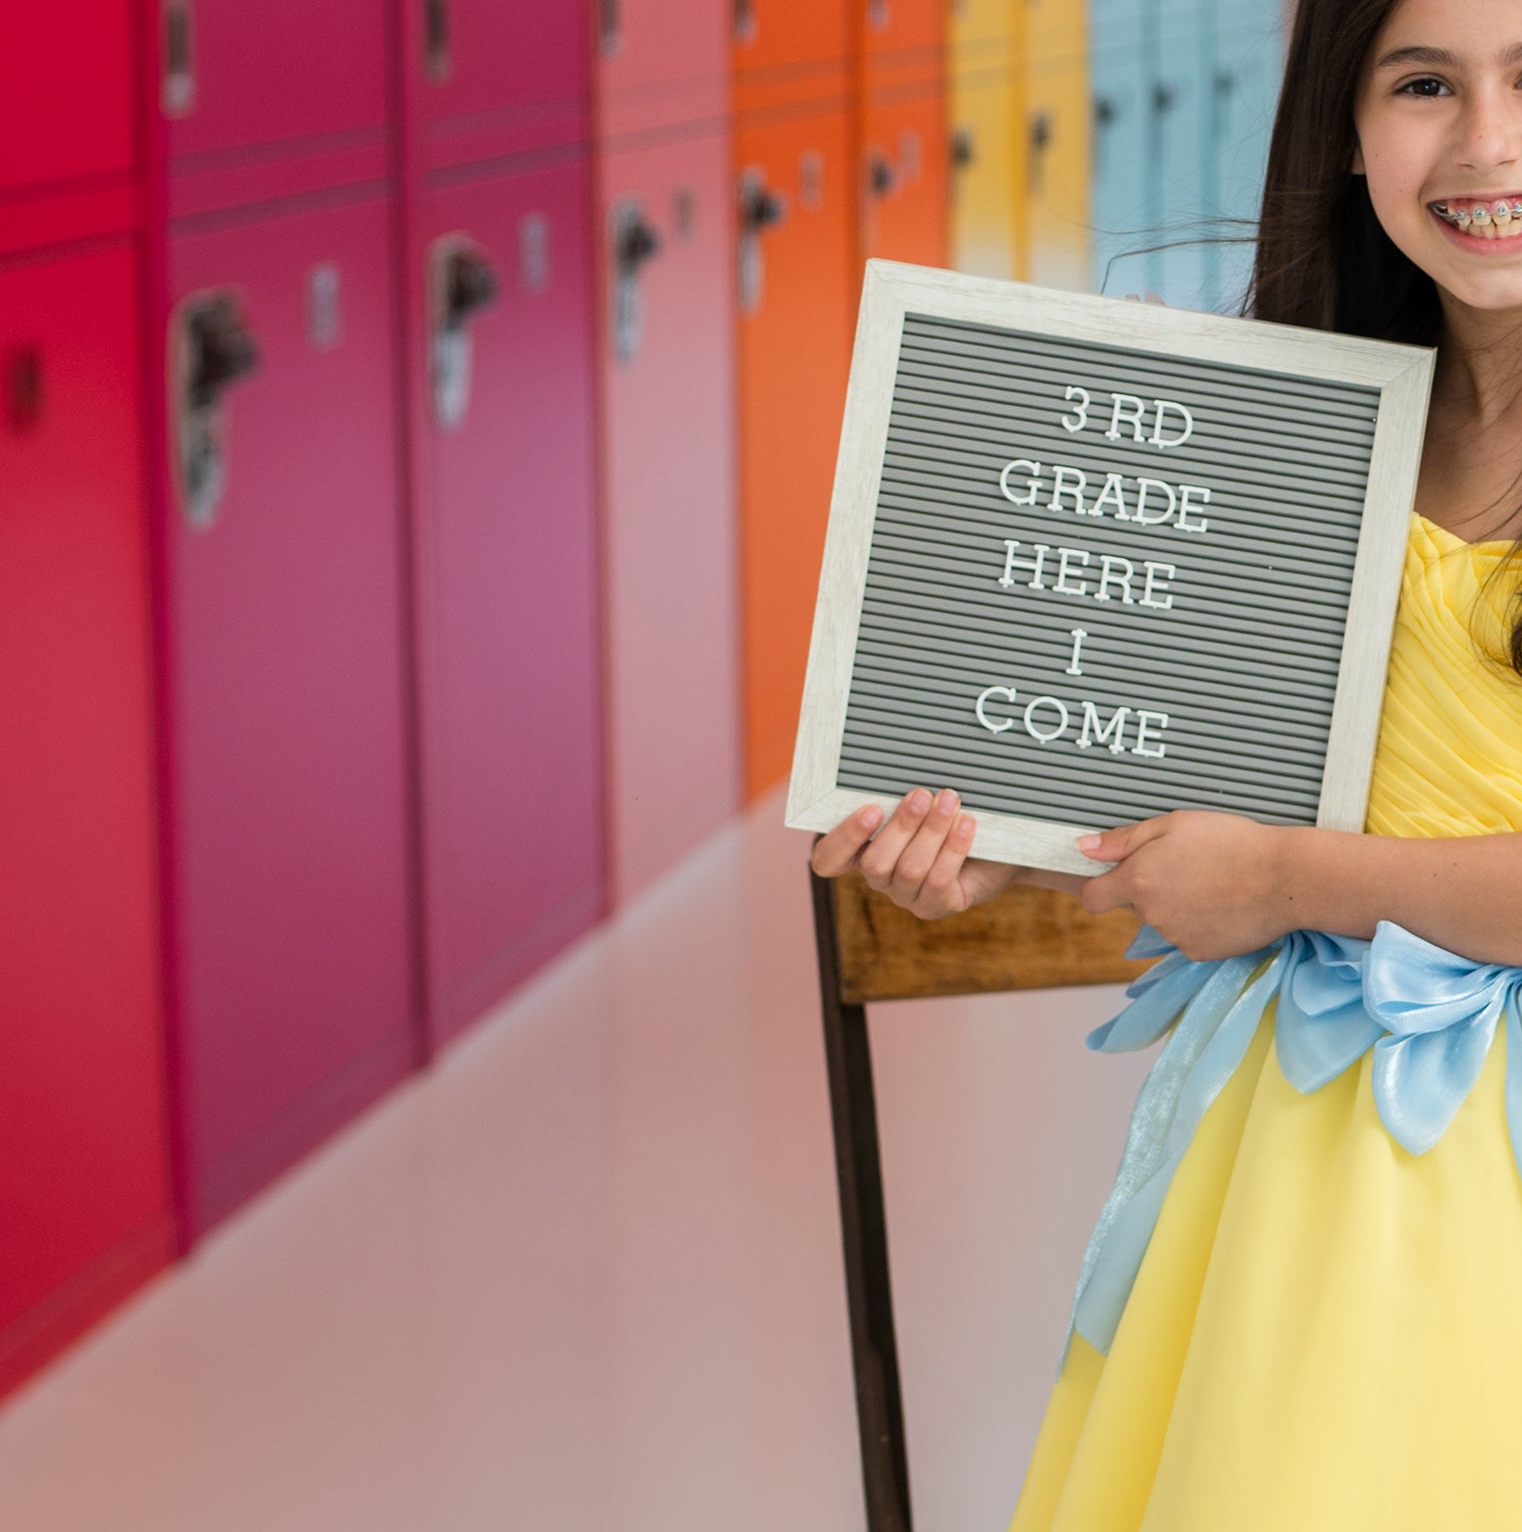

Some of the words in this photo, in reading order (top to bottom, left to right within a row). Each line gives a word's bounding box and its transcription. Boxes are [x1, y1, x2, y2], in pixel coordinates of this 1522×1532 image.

[999, 459, 1211, 532] GRADE
[998, 540, 1176, 609] HERE
[1066, 628, 1087, 675] I
[975, 686, 1169, 758] COME
